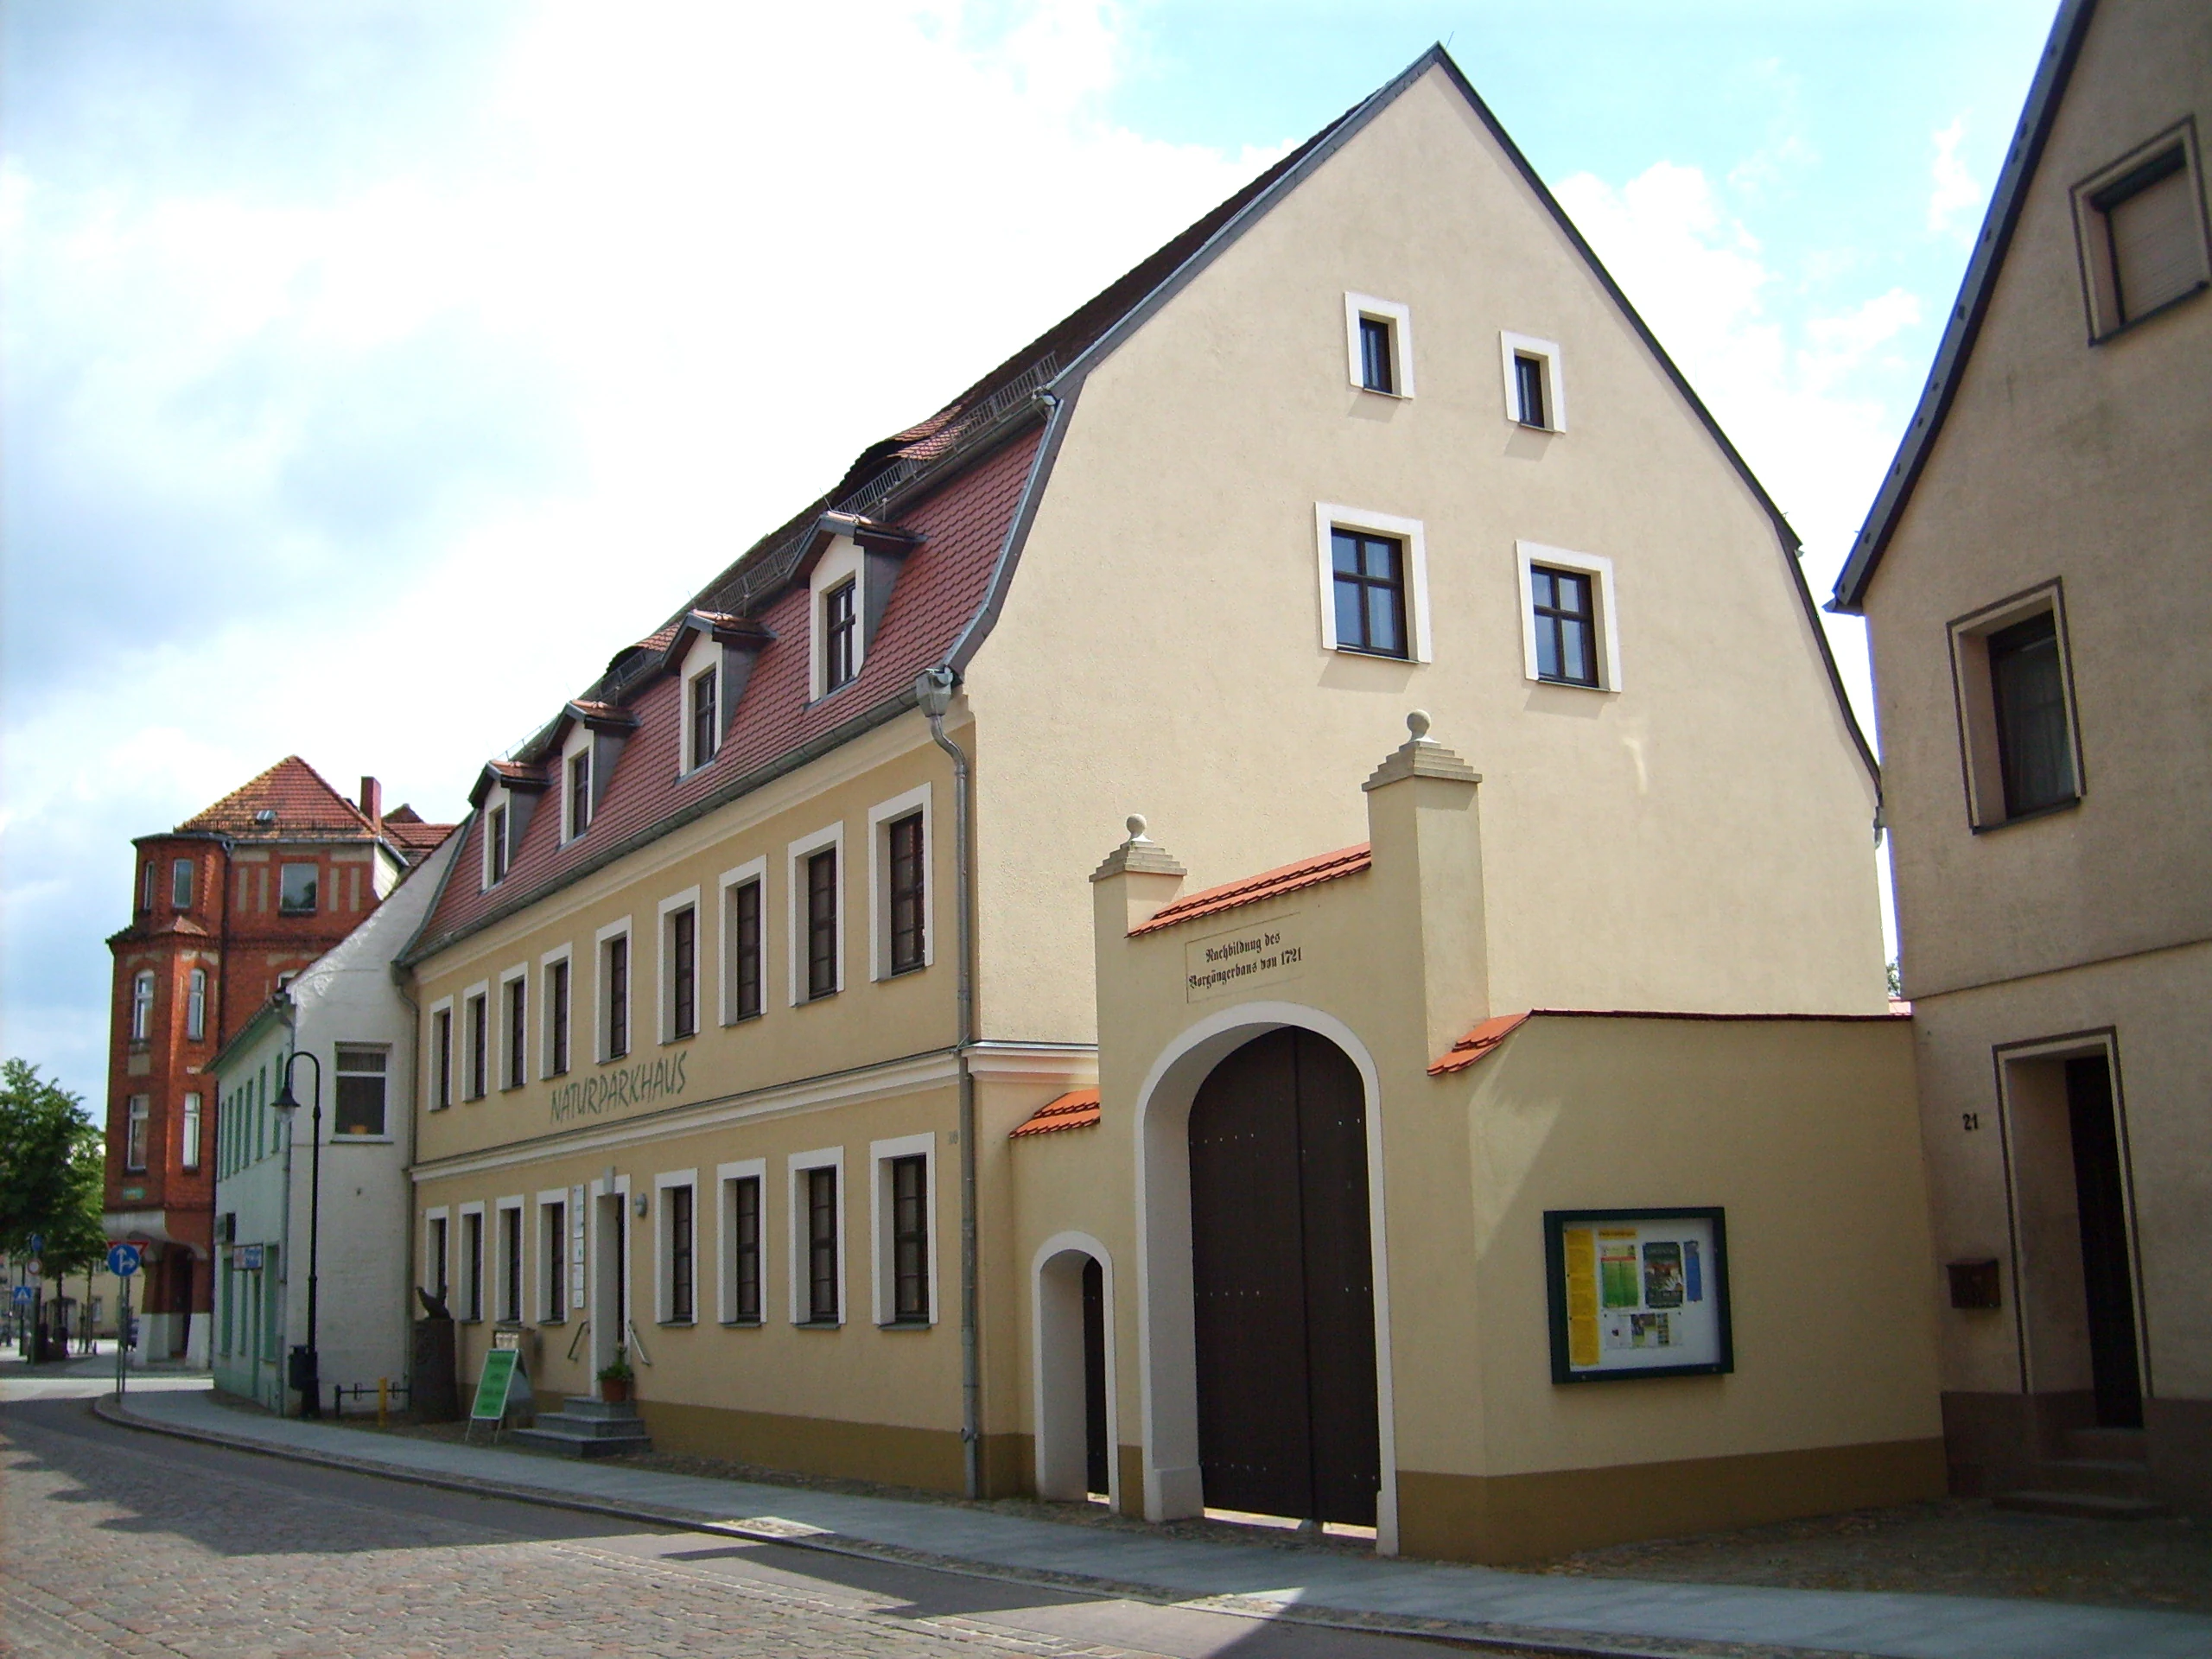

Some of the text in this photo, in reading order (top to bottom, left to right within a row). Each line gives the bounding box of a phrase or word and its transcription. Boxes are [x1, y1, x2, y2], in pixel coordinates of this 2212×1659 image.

[1205, 931, 1281, 963] Nachbildung des
[1260, 955, 1278, 970] von
[1281, 947, 1301, 965] 1721
[550, 1050, 687, 1122] NATURPARKHAUS
[1962, 1112, 1979, 1130] 21
